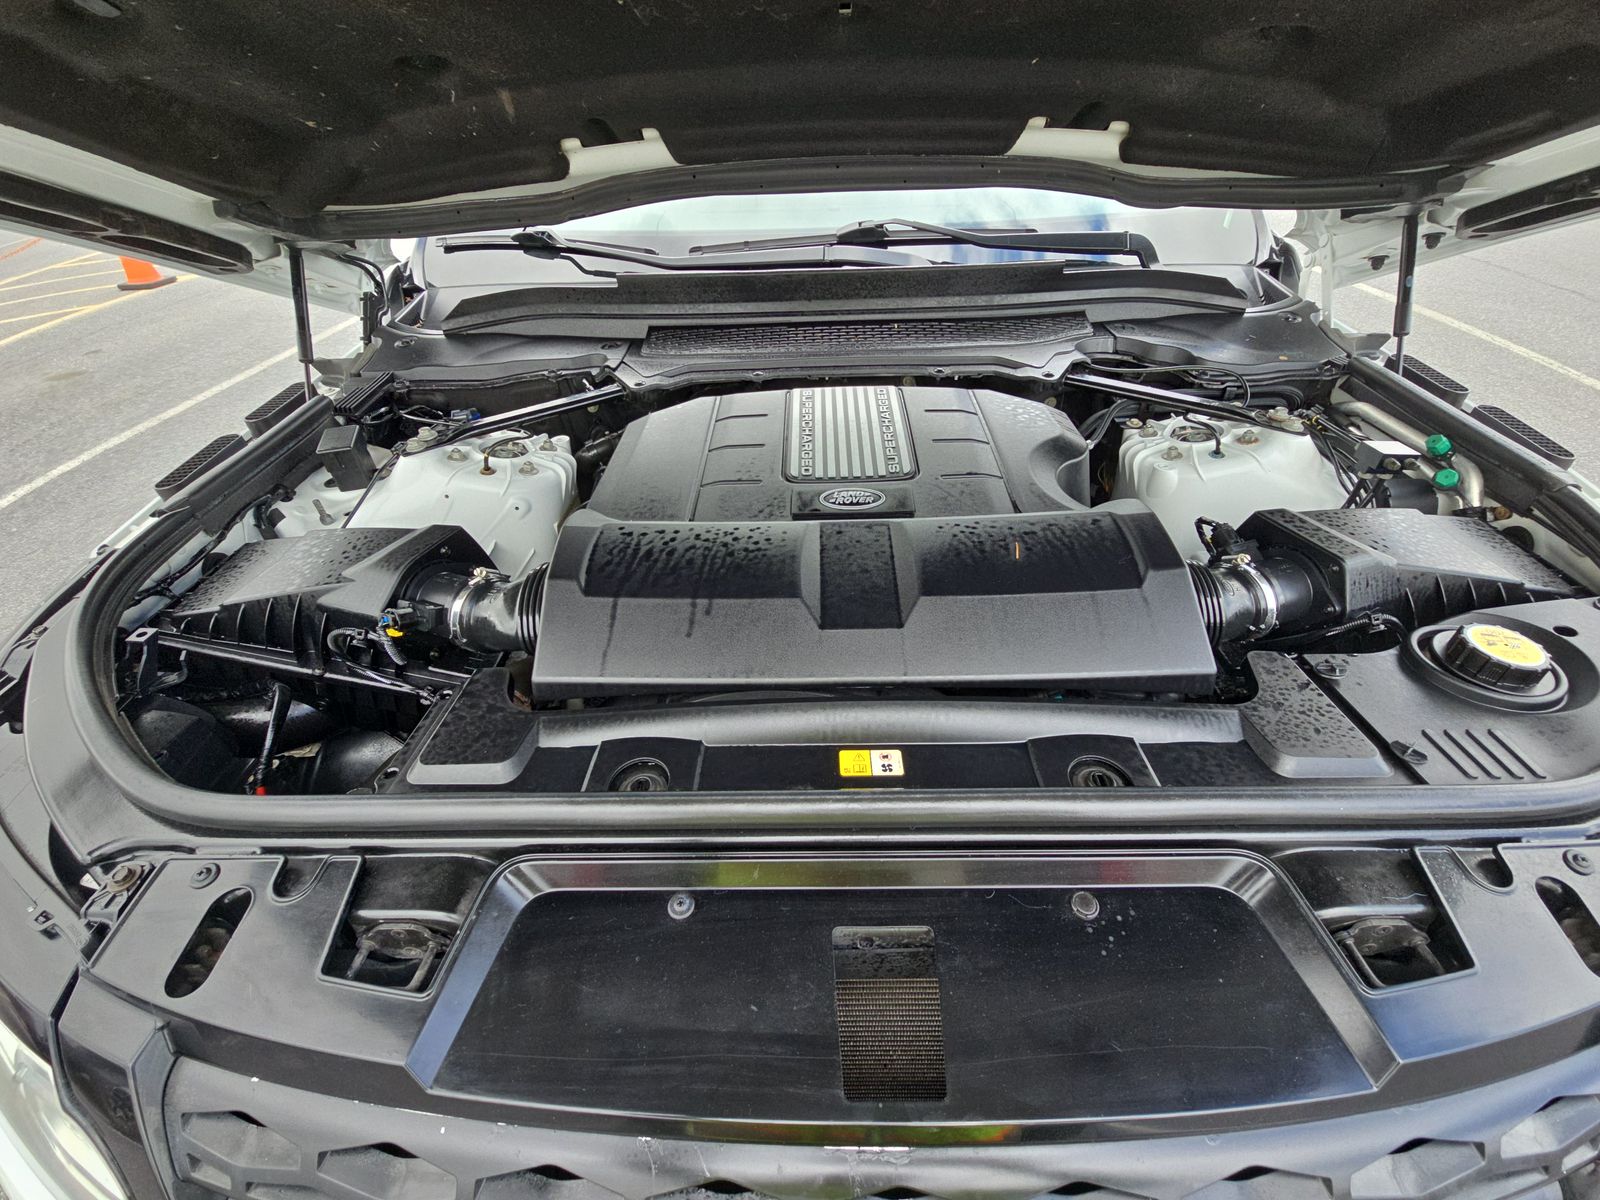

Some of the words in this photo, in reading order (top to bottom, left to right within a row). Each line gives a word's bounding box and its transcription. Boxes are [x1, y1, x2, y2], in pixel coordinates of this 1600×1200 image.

[801, 389, 813, 476] SUPERCHARGED
[877, 388, 900, 473] SUPERCHARGED
[835, 496, 874, 504] ROVER
